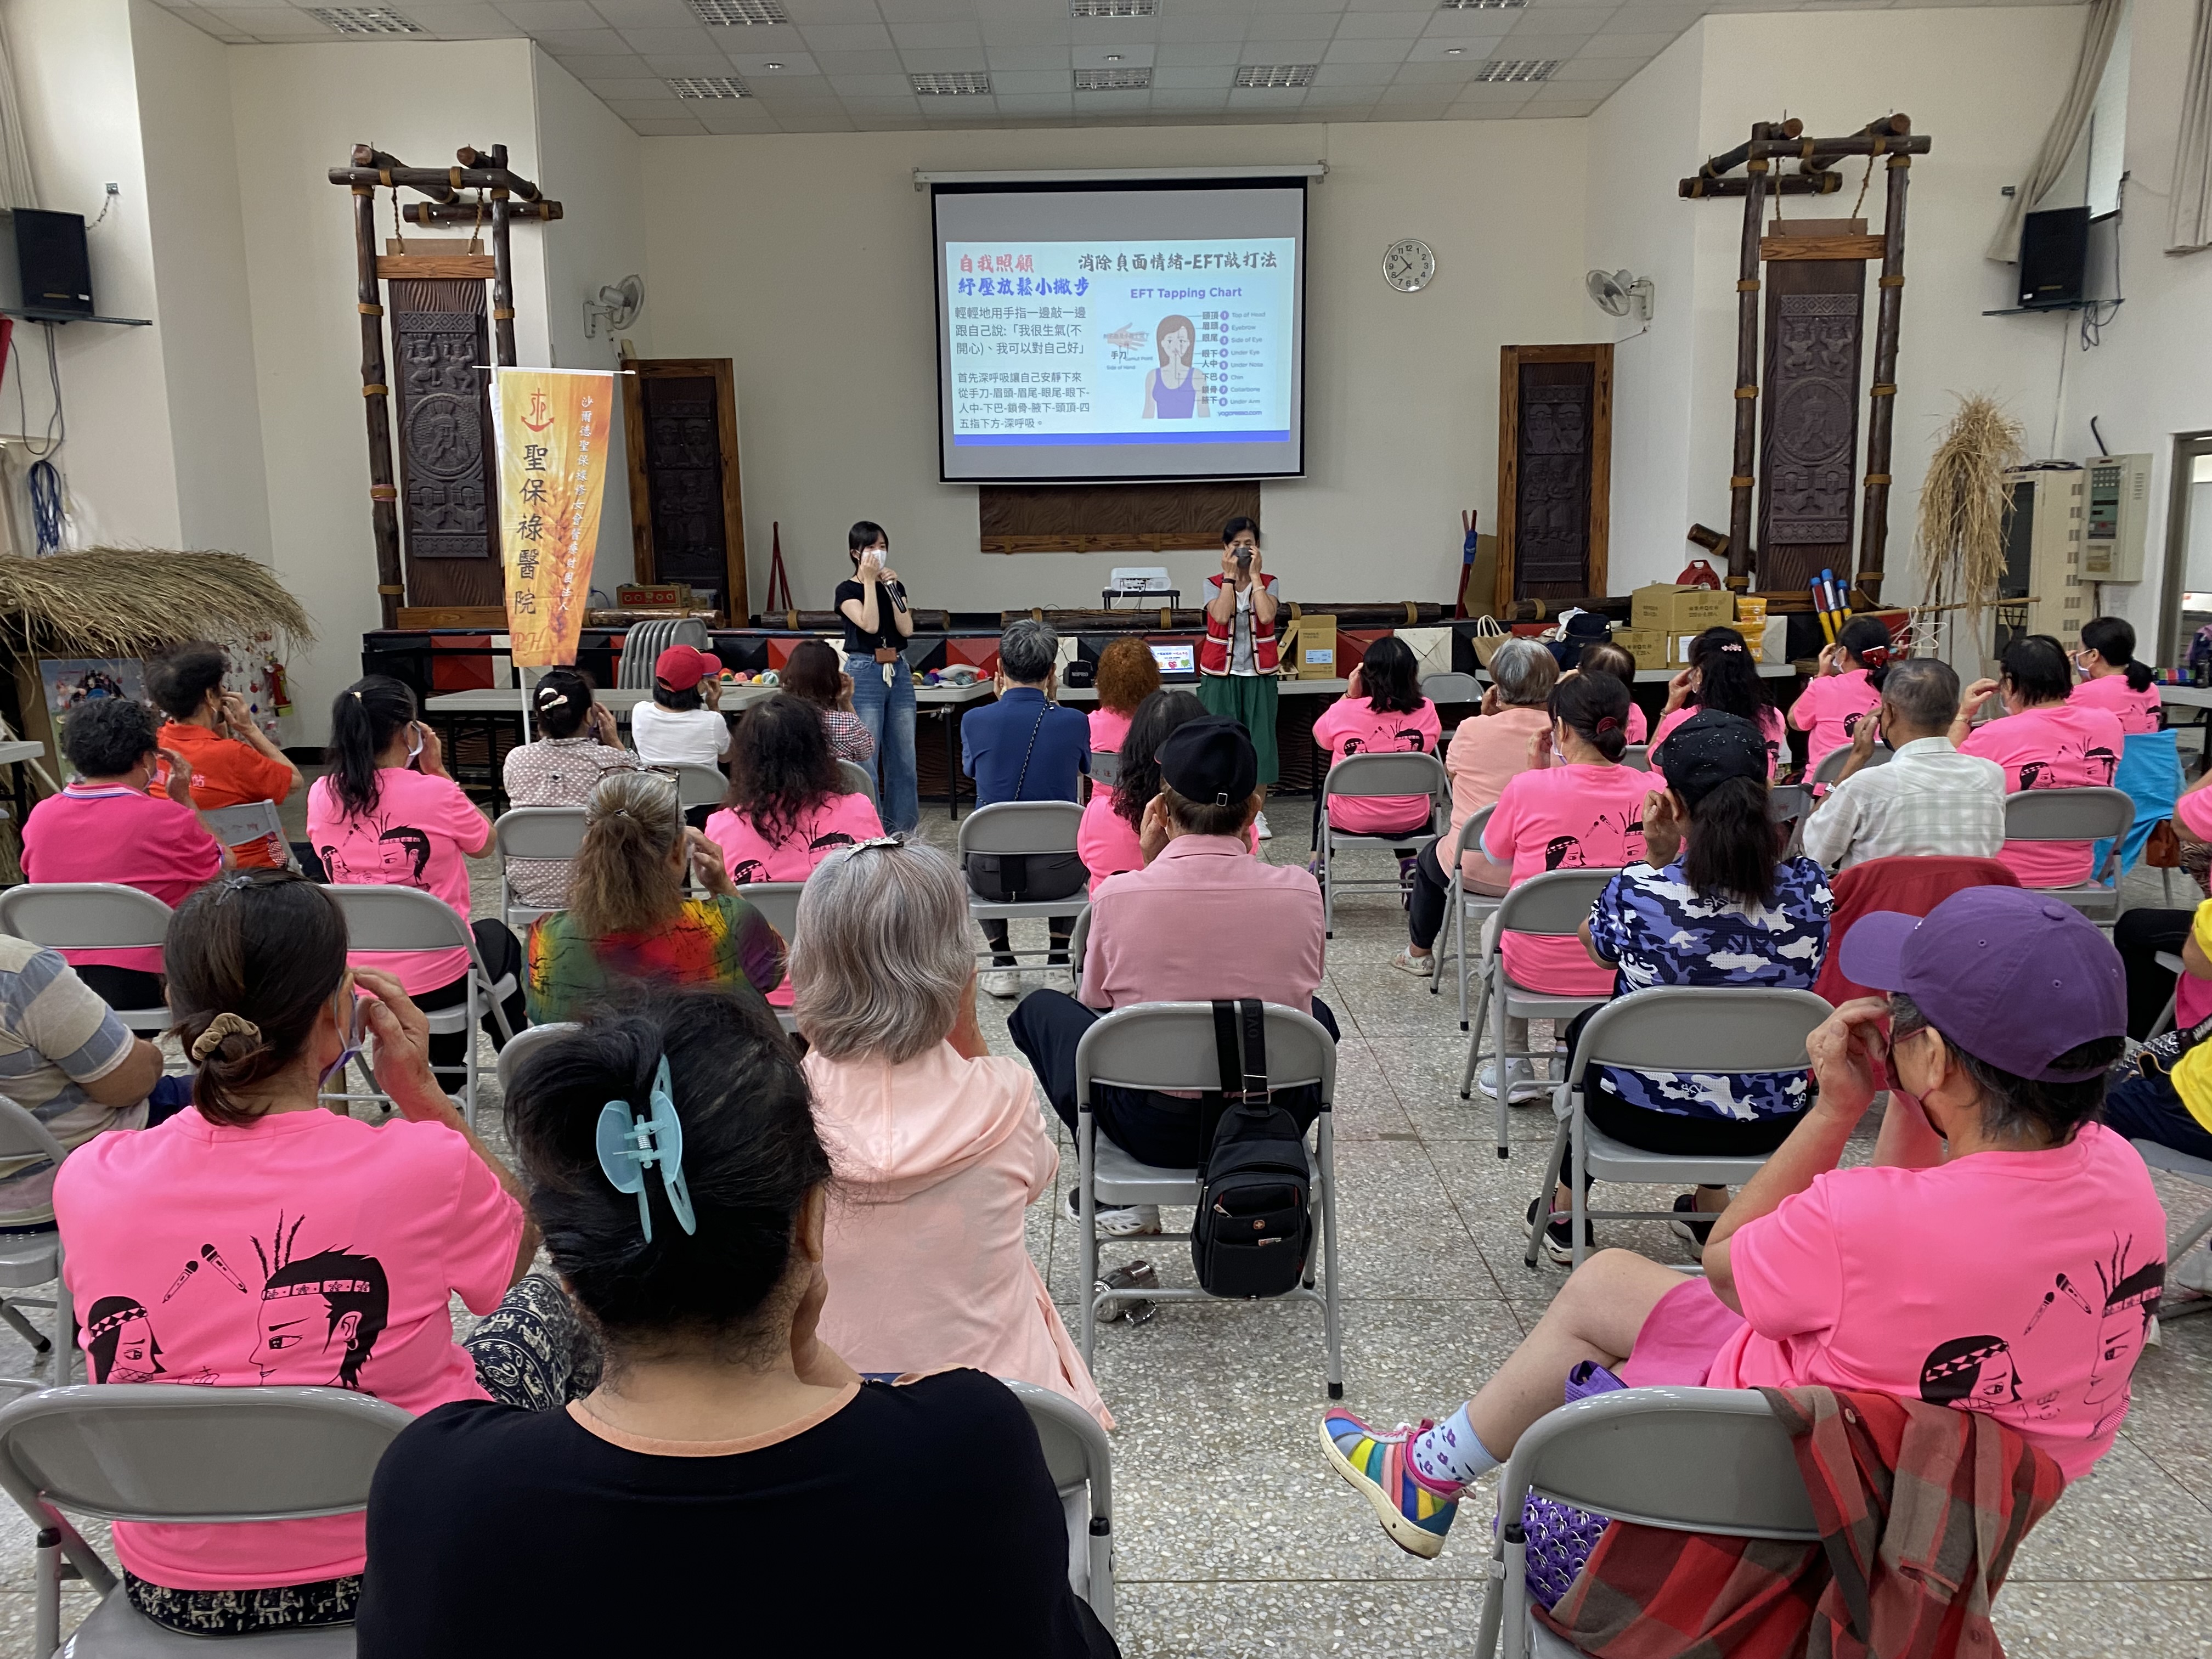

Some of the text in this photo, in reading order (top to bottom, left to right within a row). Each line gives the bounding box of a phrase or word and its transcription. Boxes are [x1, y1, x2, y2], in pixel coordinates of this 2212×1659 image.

[960, 253, 1034, 273] 自我照顧
[1078, 251, 1277, 272] 消除負面情緒-EFT敲打法
[958, 276, 1090, 296] 紓壓放鬆小撇步
[1131, 287, 1242, 300] EFT Tapping Chart
[955, 306, 1086, 319] 輕輕地用手指一邊敲一邊
[1111, 351, 1127, 359] 手刀
[1202, 359, 1217, 368] 人中
[957, 372, 1082, 383] 首先深呼吸讓自己安靜下來
[1202, 373, 1217, 381] 下巴
[514, 444, 548, 615] 聖保祿醫院
